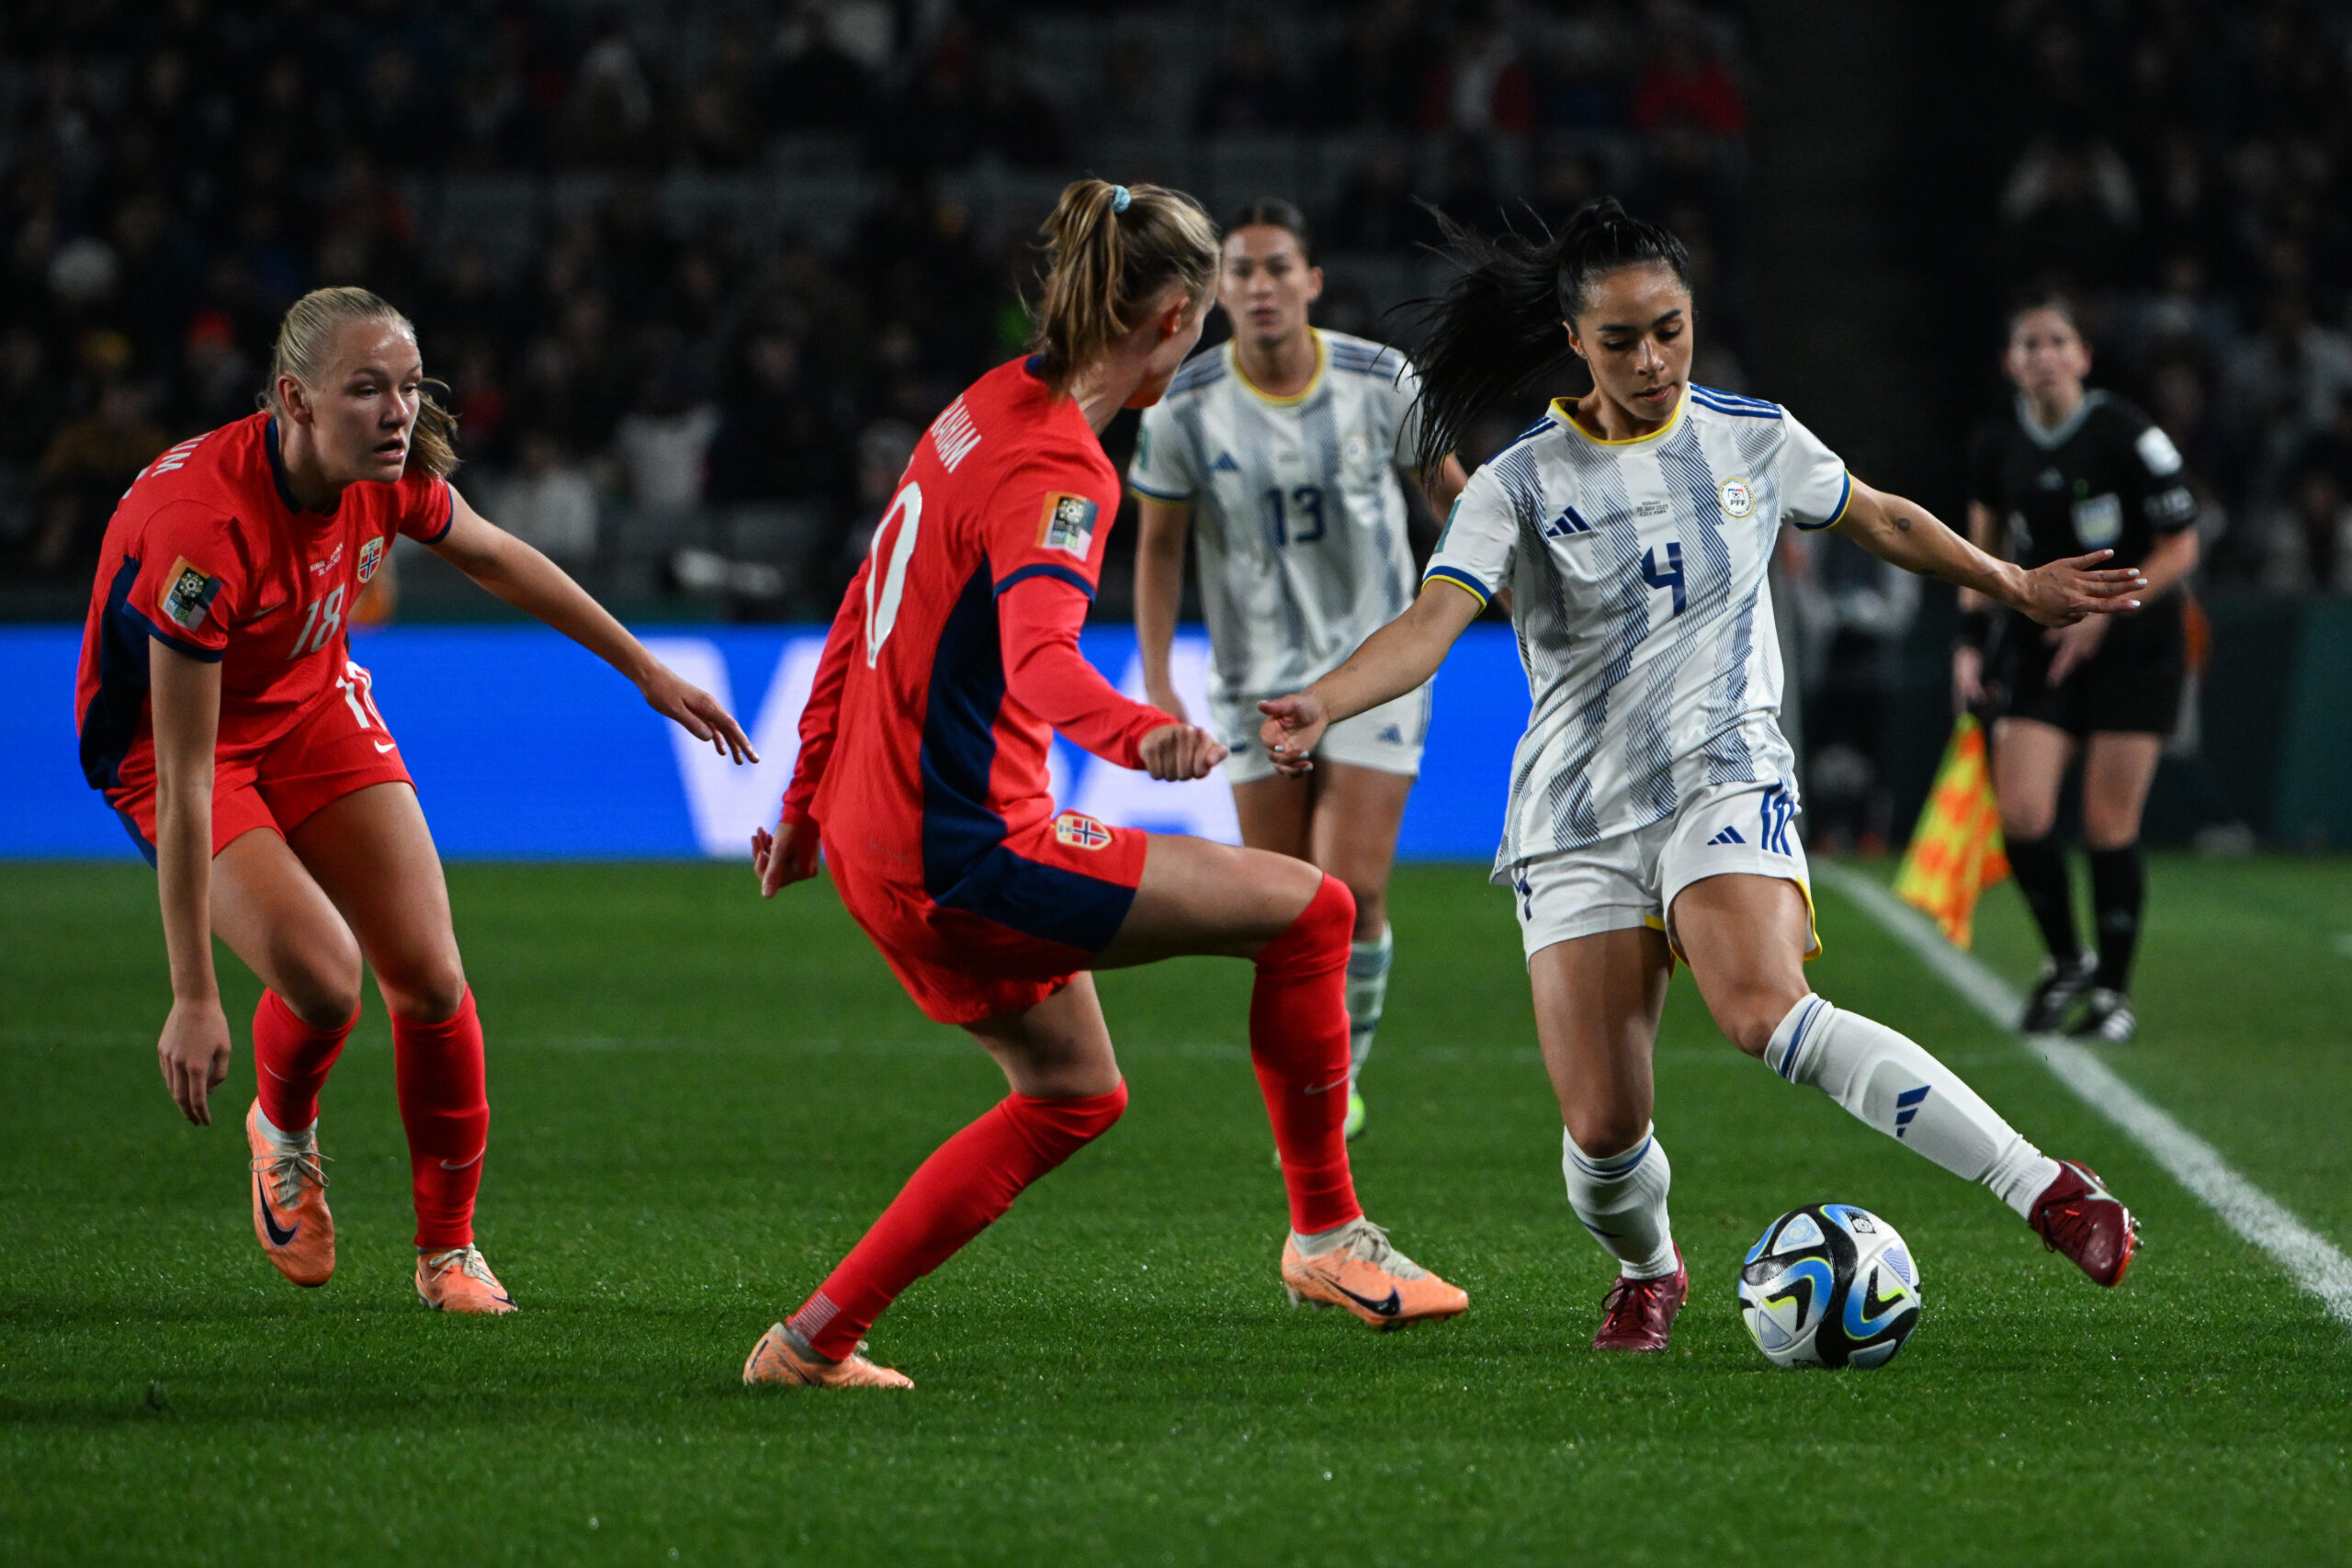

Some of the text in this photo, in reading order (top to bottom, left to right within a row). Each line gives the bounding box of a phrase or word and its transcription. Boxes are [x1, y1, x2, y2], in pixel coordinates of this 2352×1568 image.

[1266, 484, 1324, 546] 13
[865, 455, 922, 670] 0
[1642, 542, 1686, 615] 4
[287, 581, 345, 660] 18
